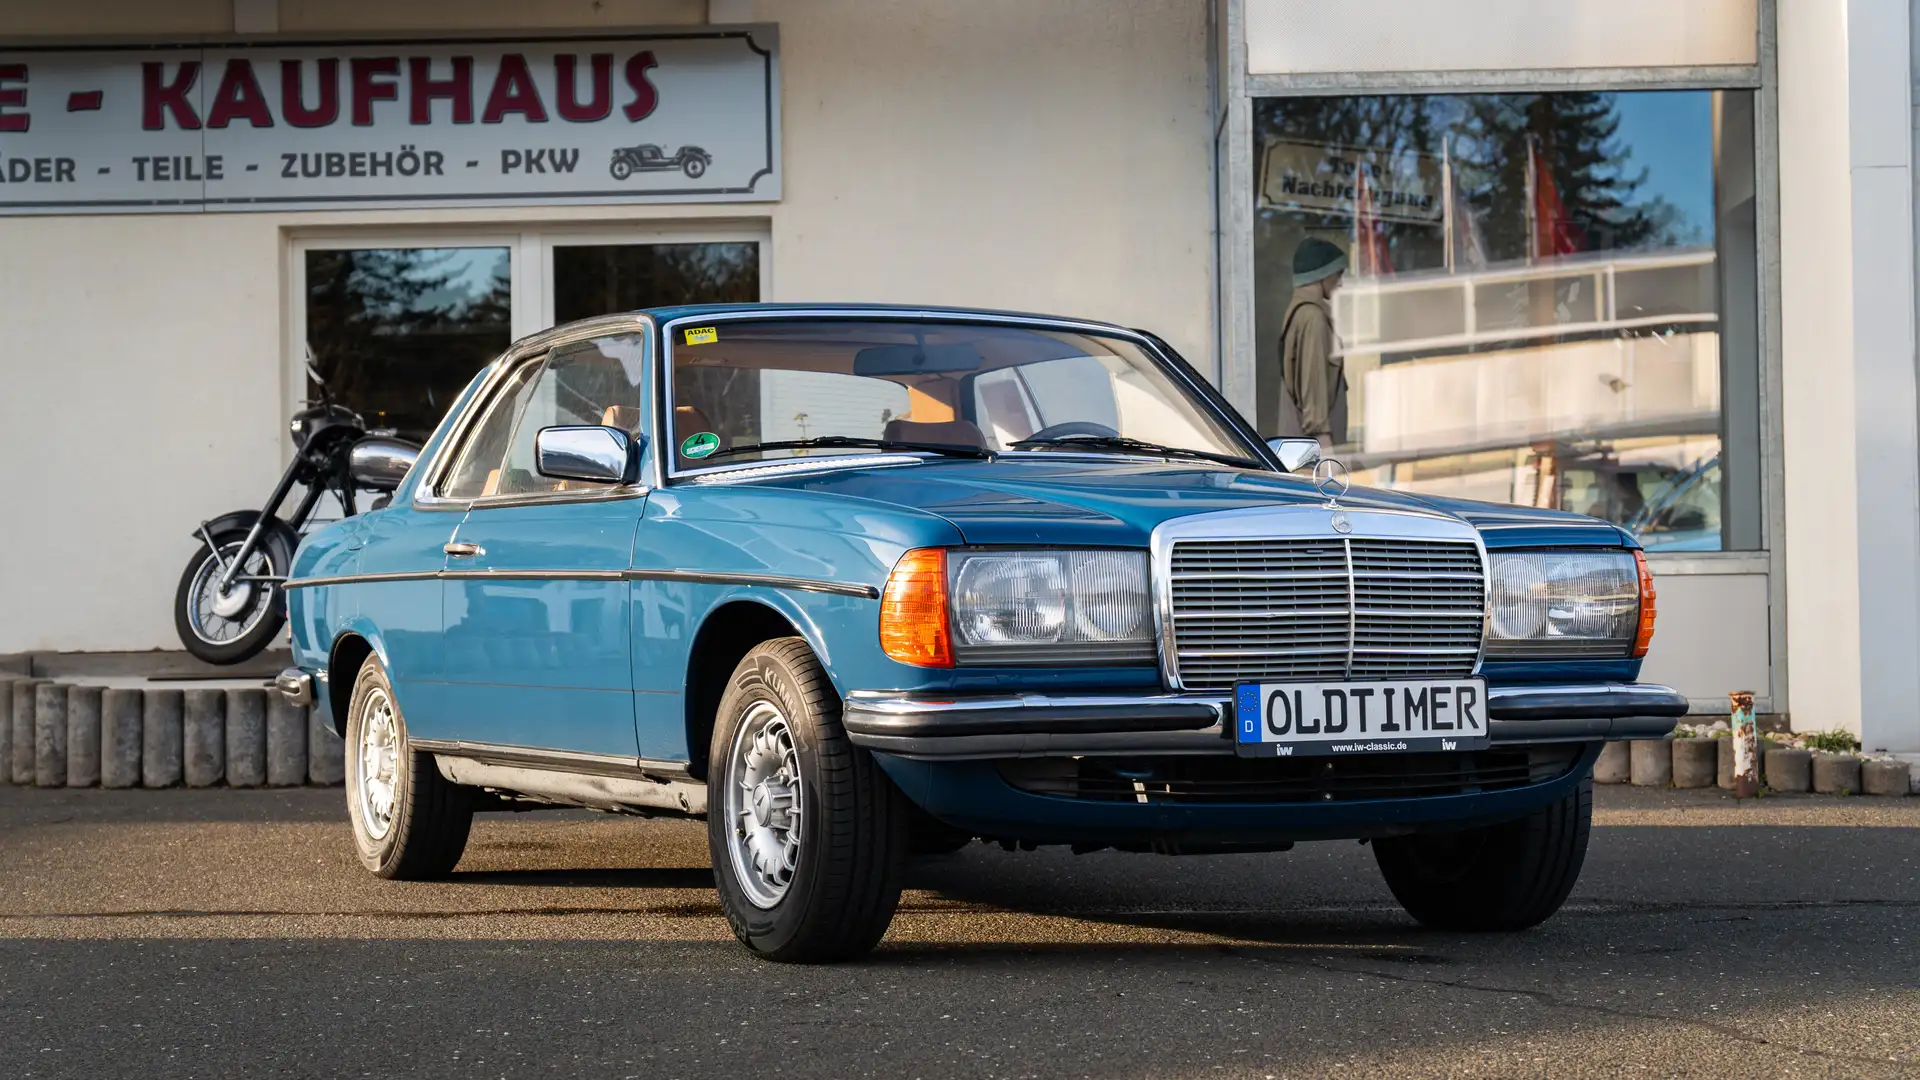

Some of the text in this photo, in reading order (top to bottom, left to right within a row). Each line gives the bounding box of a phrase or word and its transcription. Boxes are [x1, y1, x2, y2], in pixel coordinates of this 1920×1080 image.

[141, 51, 659, 131] KAUFHAUS
[0, 154, 76, 183] DER
[132, 155, 224, 181] TEILE
[280, 145, 444, 177] ZUBEHÖR
[501, 148, 579, 174] PKW
[687, 328, 714, 336] ADAC
[694, 434, 705, 445] 4
[764, 667, 801, 737] KUMHO
[1266, 686, 1480, 736] OLDTIMER
[1244, 720, 1253, 733] D
[1331, 741, 1407, 752] www.iw-classic.de
